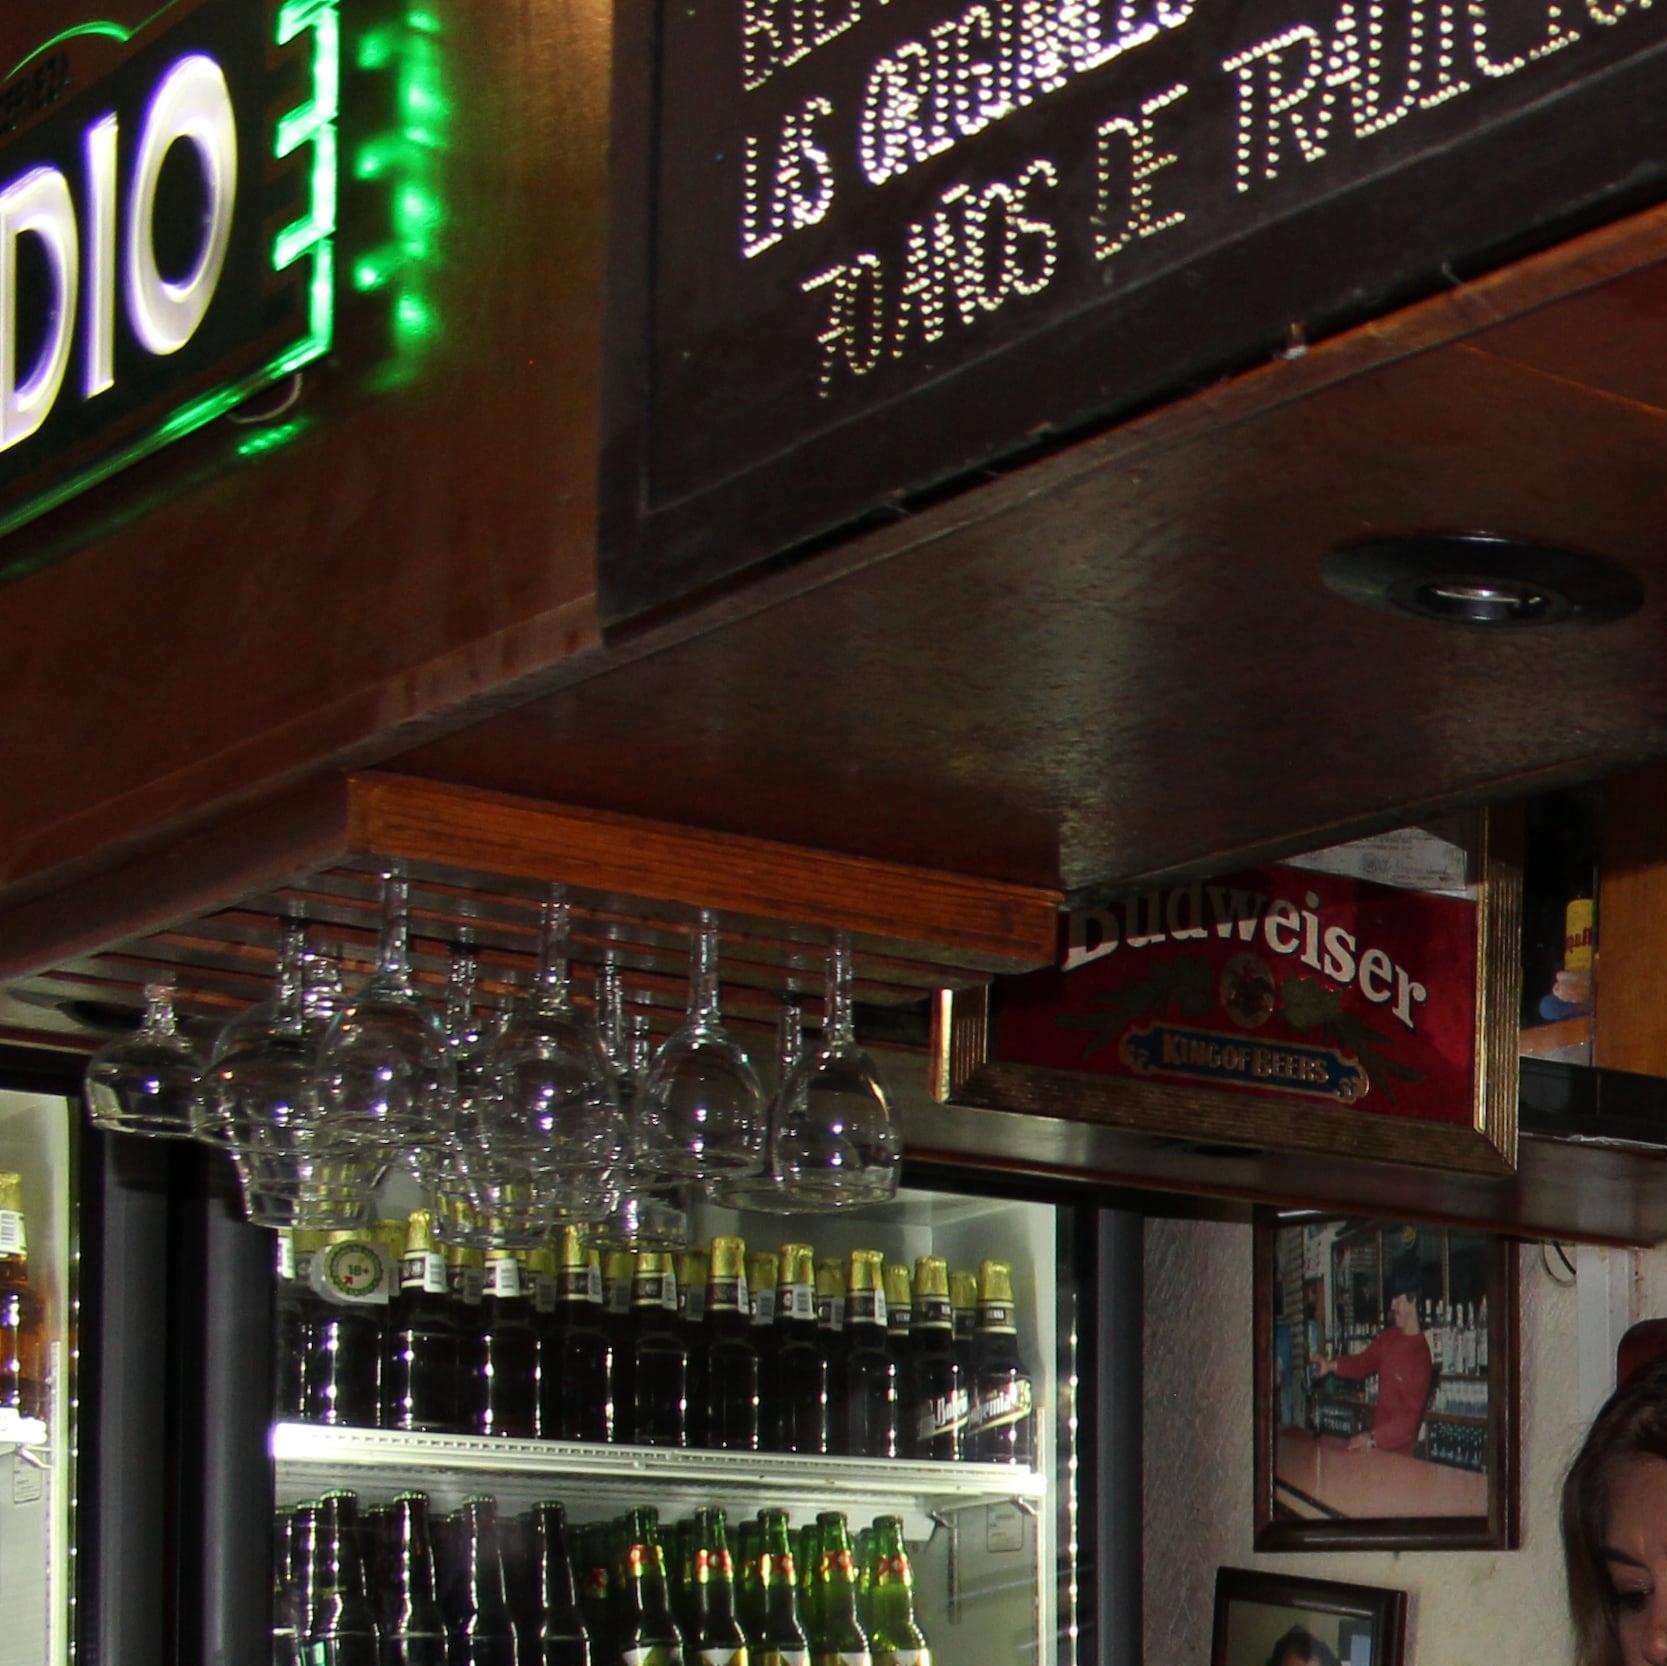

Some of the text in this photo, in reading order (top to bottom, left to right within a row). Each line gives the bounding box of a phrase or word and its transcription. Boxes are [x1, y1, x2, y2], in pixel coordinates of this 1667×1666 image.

[0, 50, 239, 453] DIO
[741, 97, 834, 260] LAS
[859, 0, 1198, 186] ORIGINAL
[801, 252, 881, 399] 70
[893, 157, 1059, 358] AÑOS
[1093, 84, 1189, 260] DE
[1061, 878, 1428, 1031] Budweiser
[1162, 1033, 1330, 1084] KING OF BEERS
